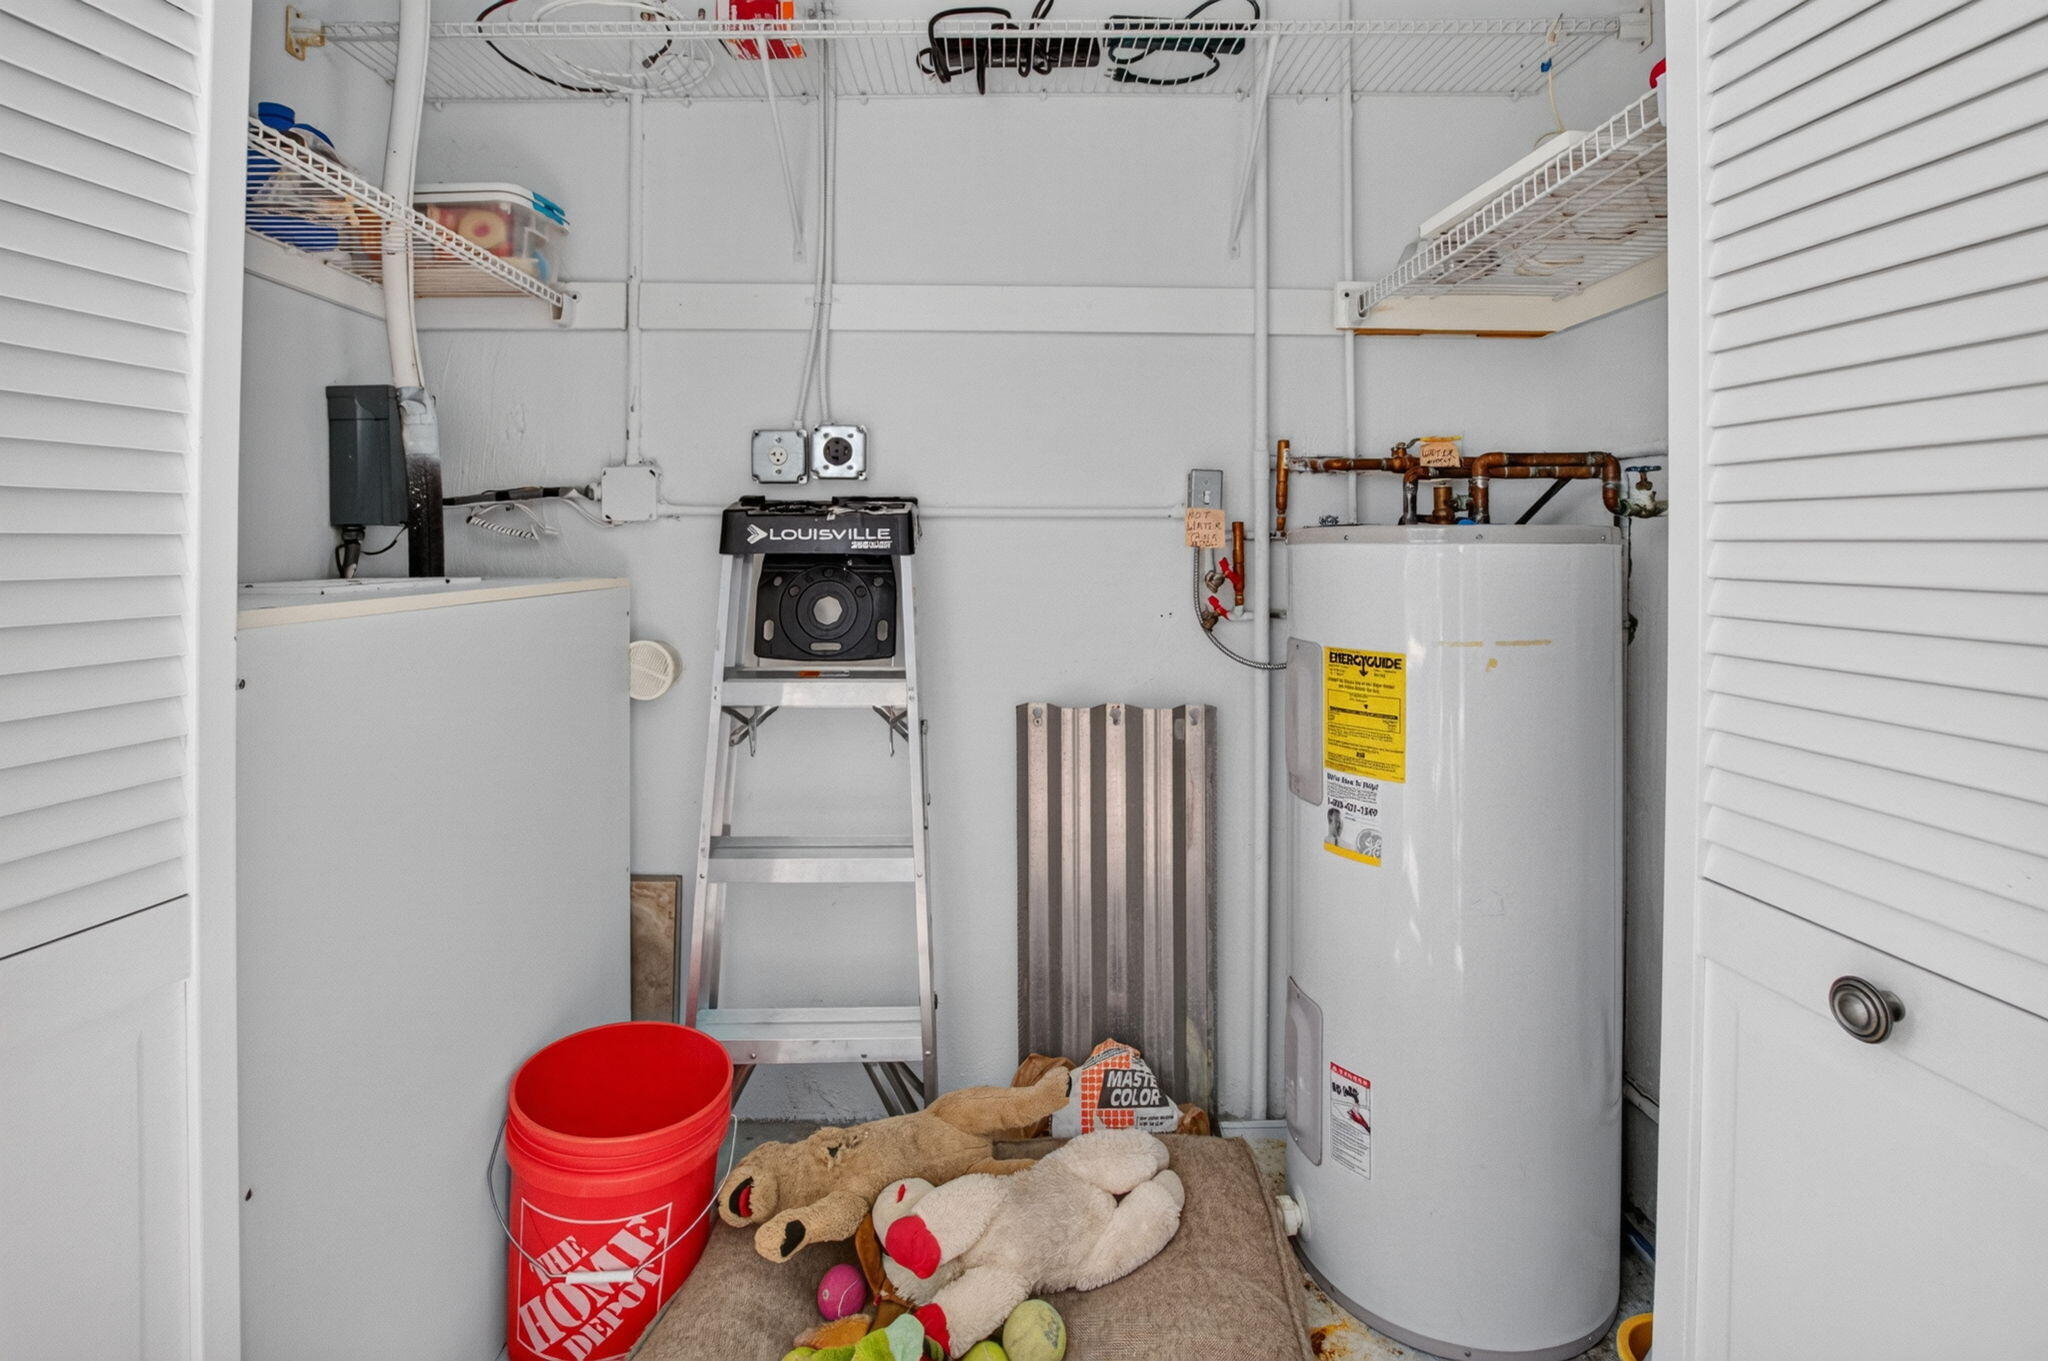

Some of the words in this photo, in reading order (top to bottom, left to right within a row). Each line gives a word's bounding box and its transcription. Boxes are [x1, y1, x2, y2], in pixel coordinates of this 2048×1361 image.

[769, 528, 891, 541] LOUISVILLE
[1110, 1088, 1161, 1107] COLOR
[519, 1216, 667, 1353] HOME
[529, 1235, 590, 1286] THE
[562, 1263, 662, 1361] DEPOT
